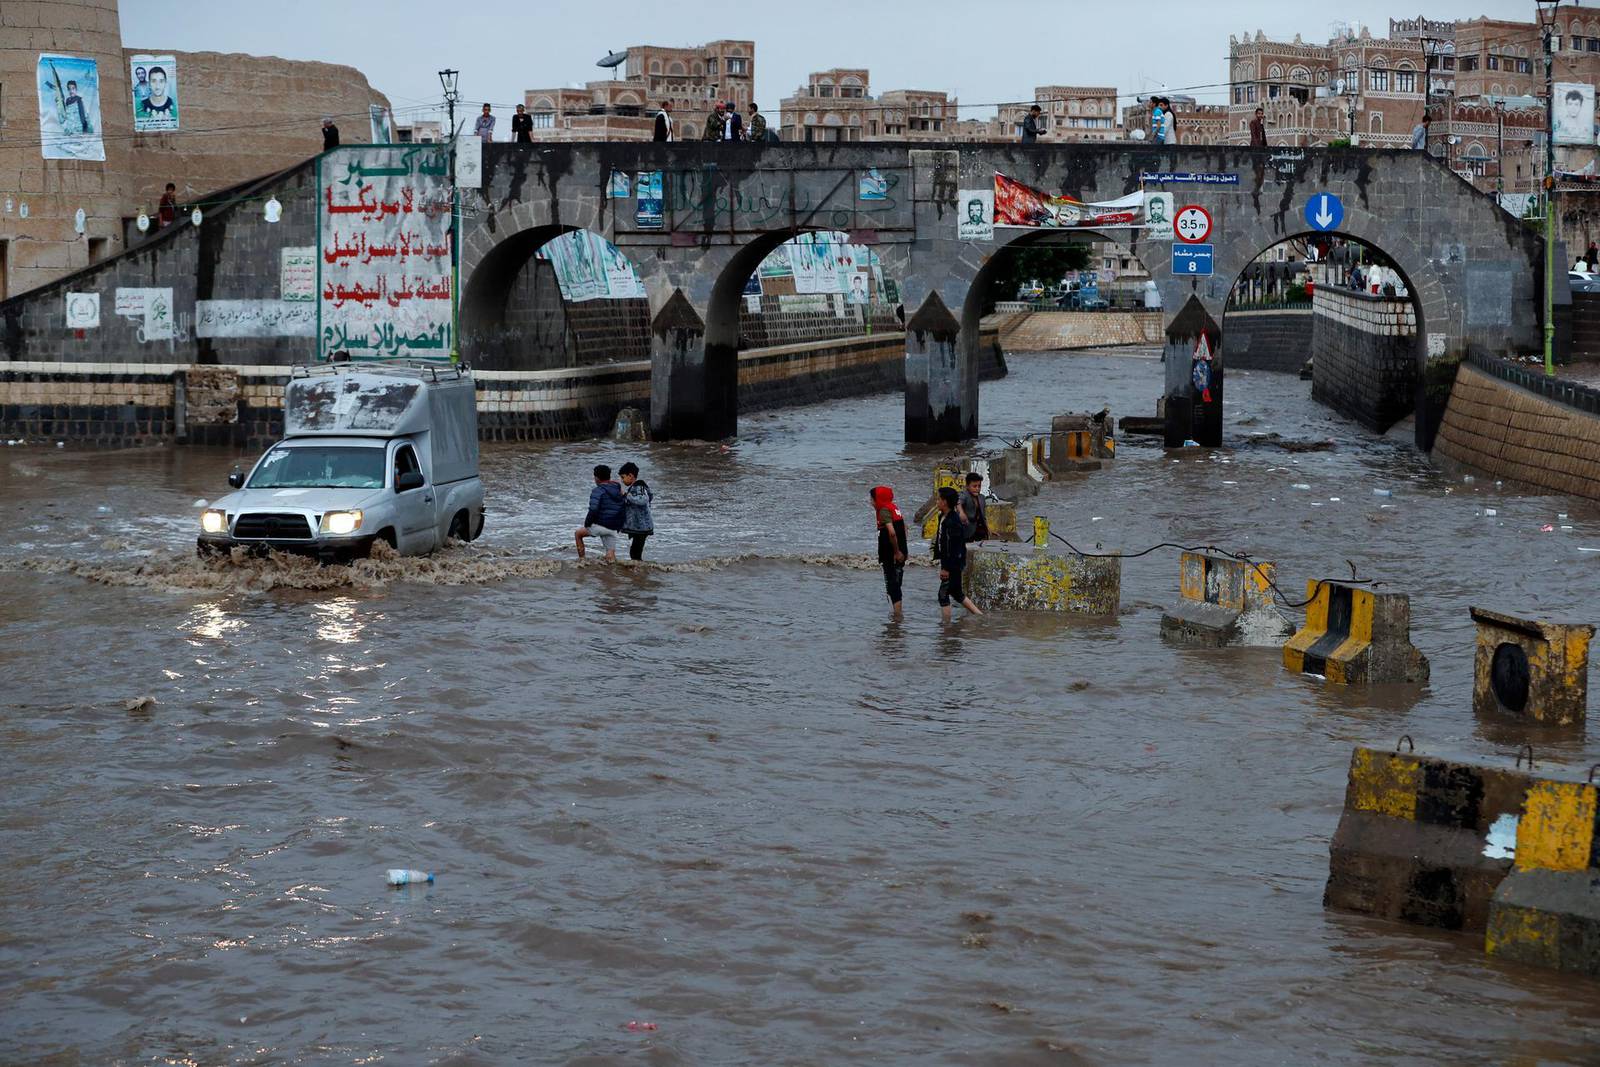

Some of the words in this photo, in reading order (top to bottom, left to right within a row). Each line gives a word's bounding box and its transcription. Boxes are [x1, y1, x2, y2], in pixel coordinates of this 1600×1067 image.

[418, 153, 447, 177] لله
[1180, 219, 1198, 229] 3.5
[412, 230, 449, 261] لموت
[1189, 261, 1196, 271] 8
[324, 273, 388, 309] اليهود
[415, 275, 450, 299] للعنة
[387, 321, 450, 355] النصر
